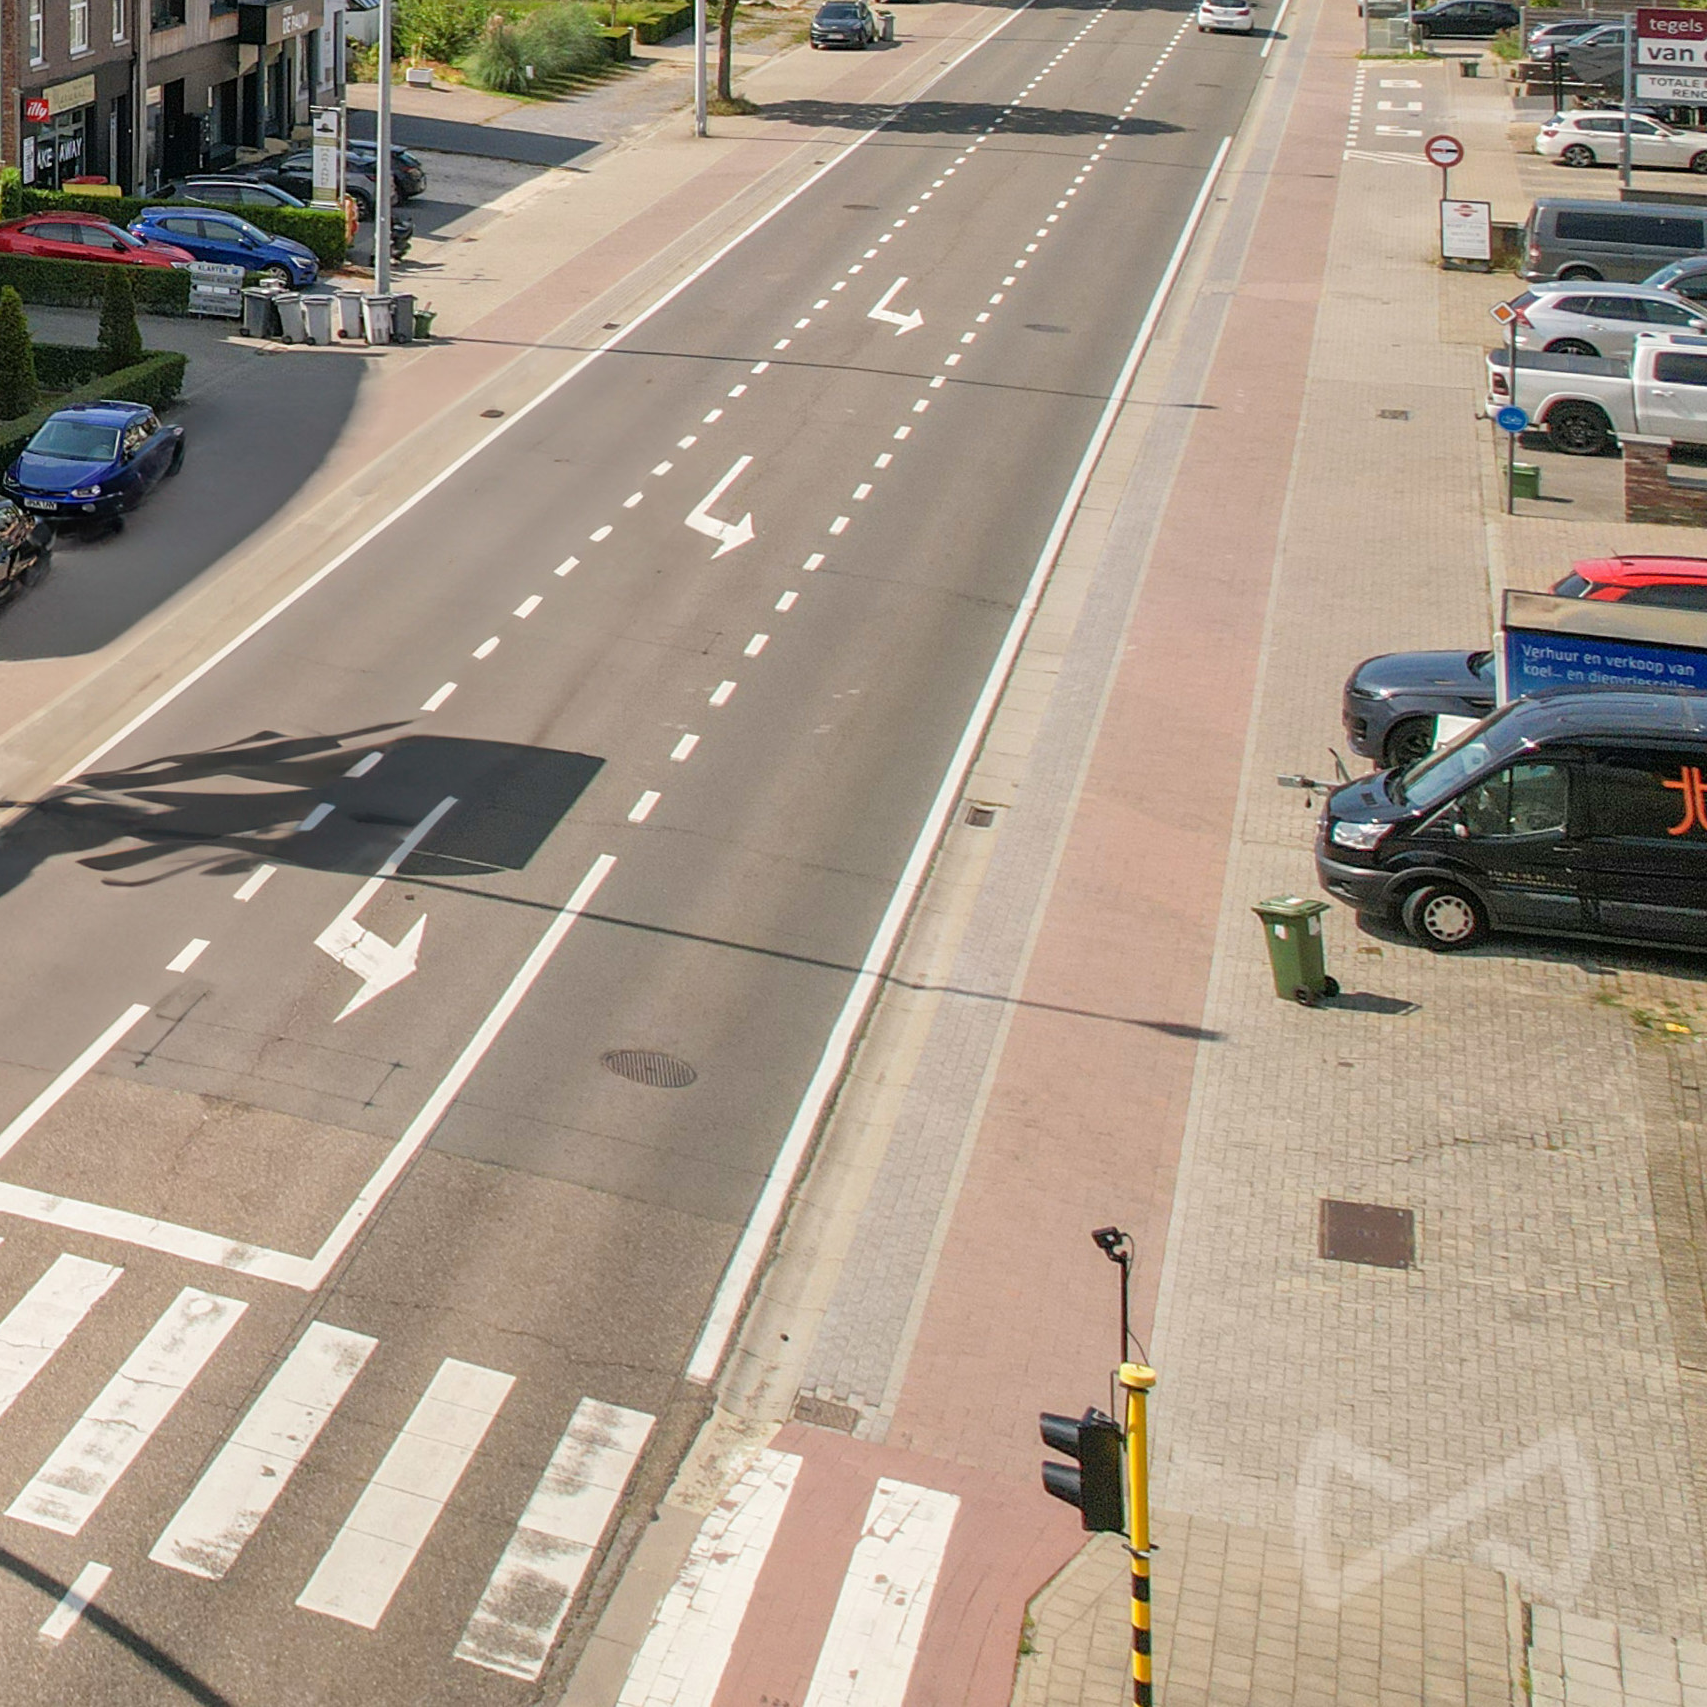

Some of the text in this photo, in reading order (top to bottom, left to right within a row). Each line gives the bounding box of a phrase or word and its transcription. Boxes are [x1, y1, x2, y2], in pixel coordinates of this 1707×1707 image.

[1649, 18, 1704, 34] tegels
[1647, 46, 1694, 62] van
[1648, 77, 1701, 89] TOTALE
[27, 101, 48, 120] illy
[59, 137, 83, 163] AWAY
[1521, 643, 1695, 676] Verhuur en verkoop van
[1567, 669, 1584, 681] en
